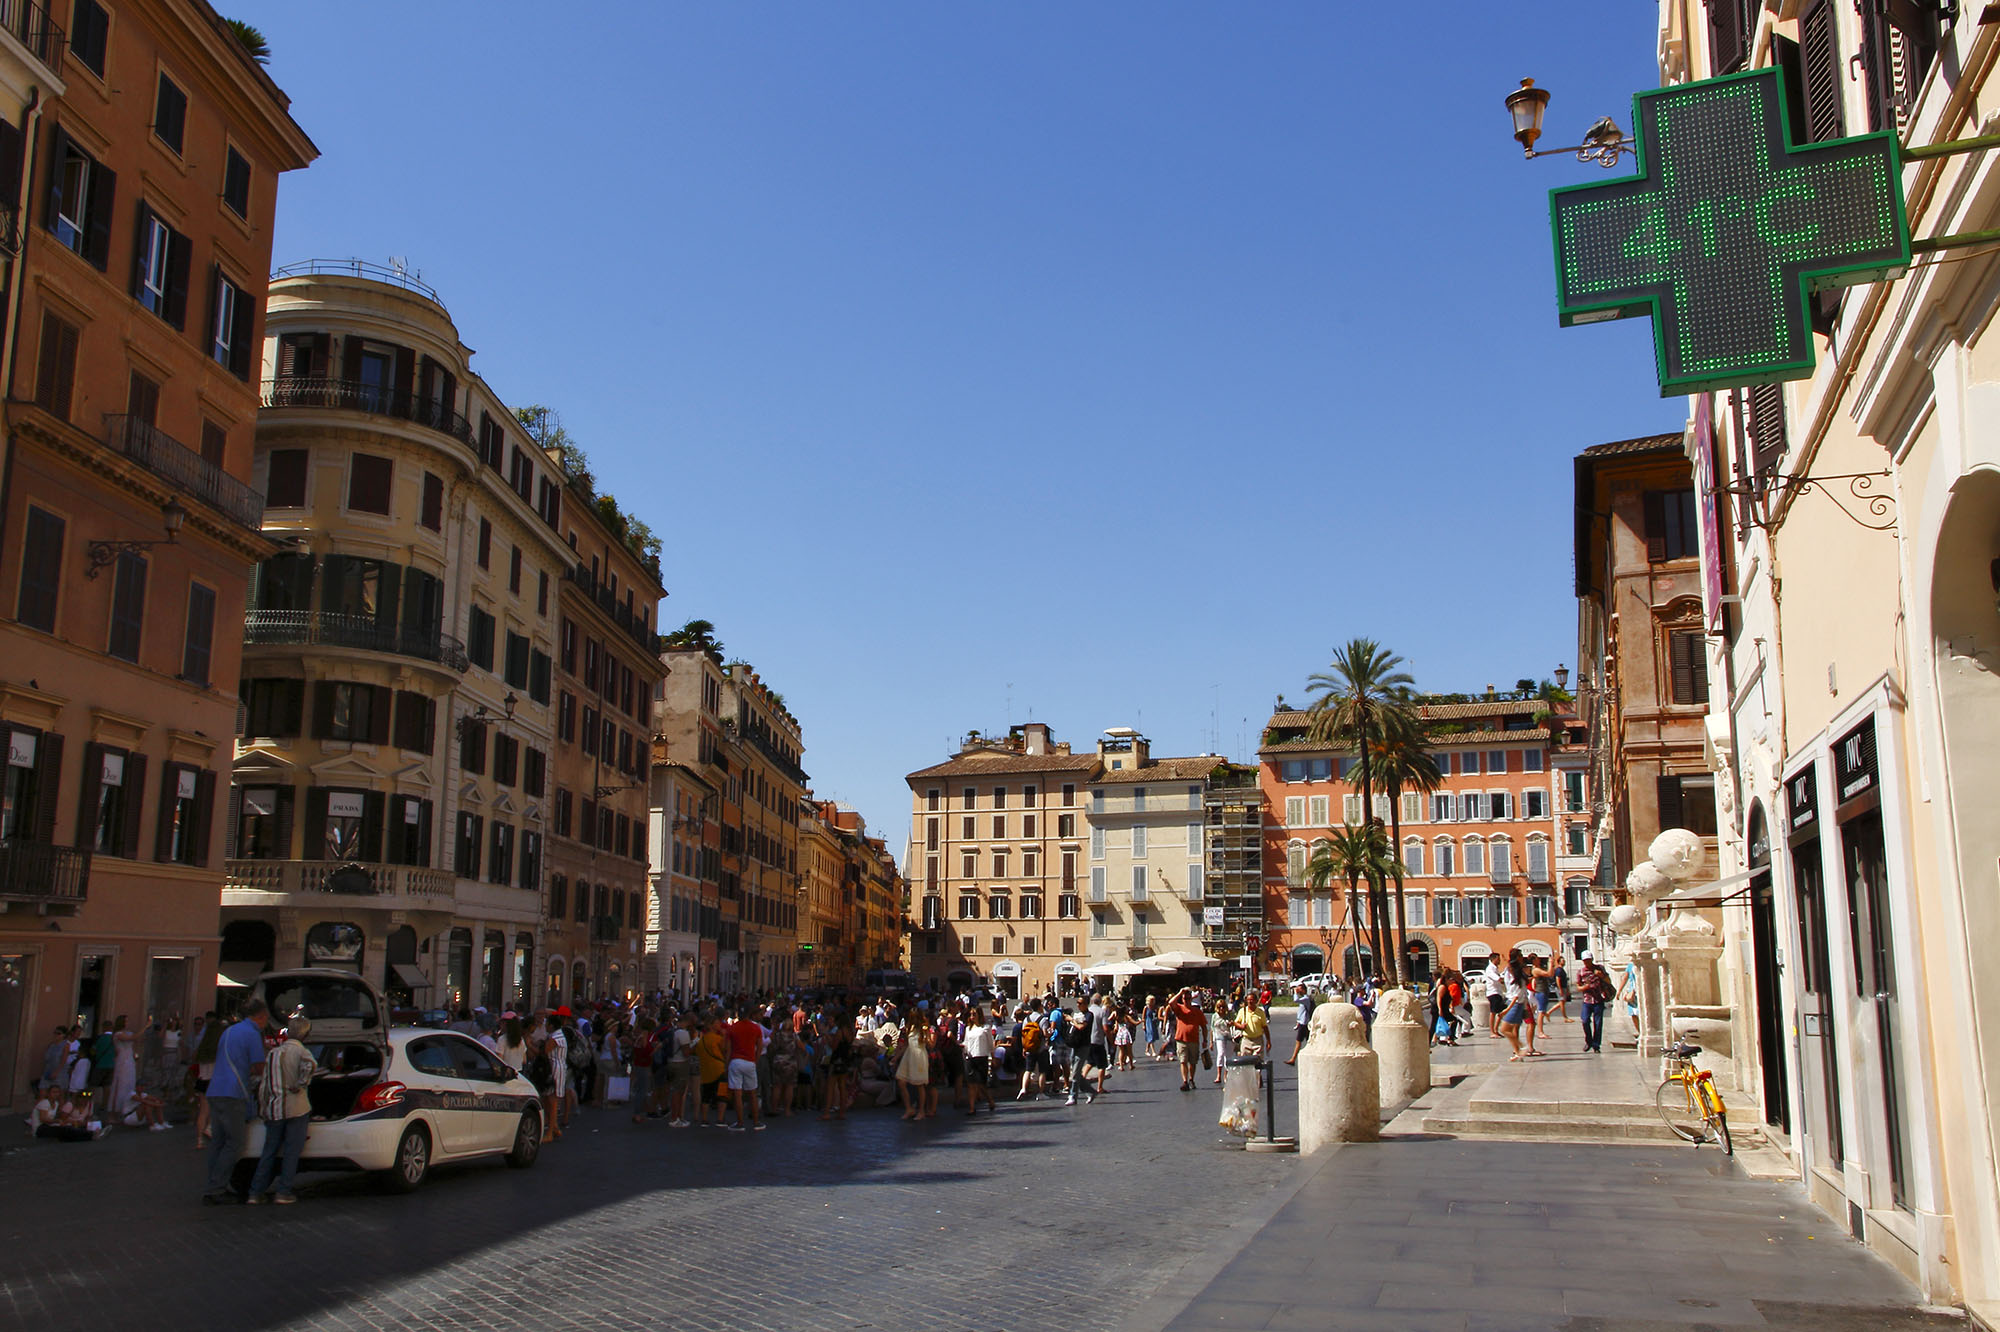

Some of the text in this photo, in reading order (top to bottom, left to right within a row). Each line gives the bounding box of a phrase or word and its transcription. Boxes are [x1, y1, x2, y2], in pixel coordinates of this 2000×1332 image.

[9, 746, 28, 763] Dior
[1845, 733, 1863, 773] IWC
[333, 804, 359, 812] PRADA
[1247, 939, 1259, 948] M
